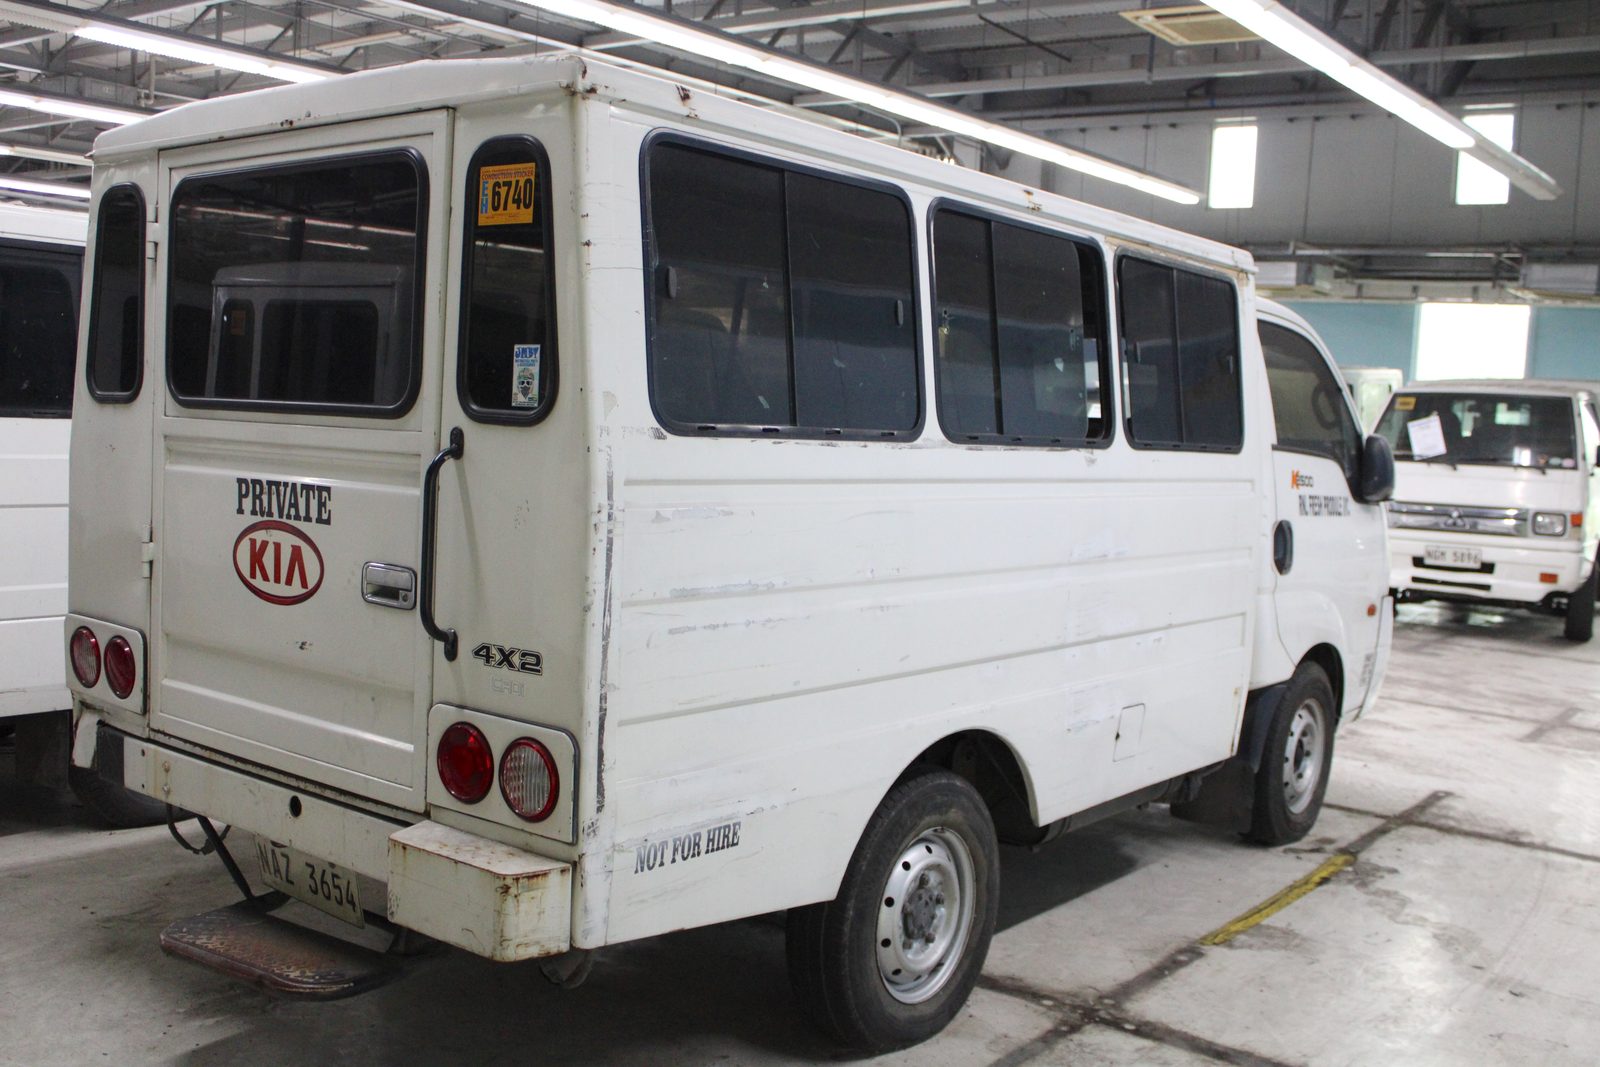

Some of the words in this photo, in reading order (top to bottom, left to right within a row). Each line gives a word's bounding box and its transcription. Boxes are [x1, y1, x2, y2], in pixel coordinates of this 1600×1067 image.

[491, 178, 533, 212] 6740
[236, 477, 331, 526] PRIVATE
[249, 537, 309, 590] KIA
[472, 642, 543, 676] 4X2
[634, 840, 668, 875] NOT
[670, 832, 702, 864] FOR
[704, 821, 741, 855] HIRE
[257, 842, 295, 886] NAZ
[305, 862, 356, 913] 3654
